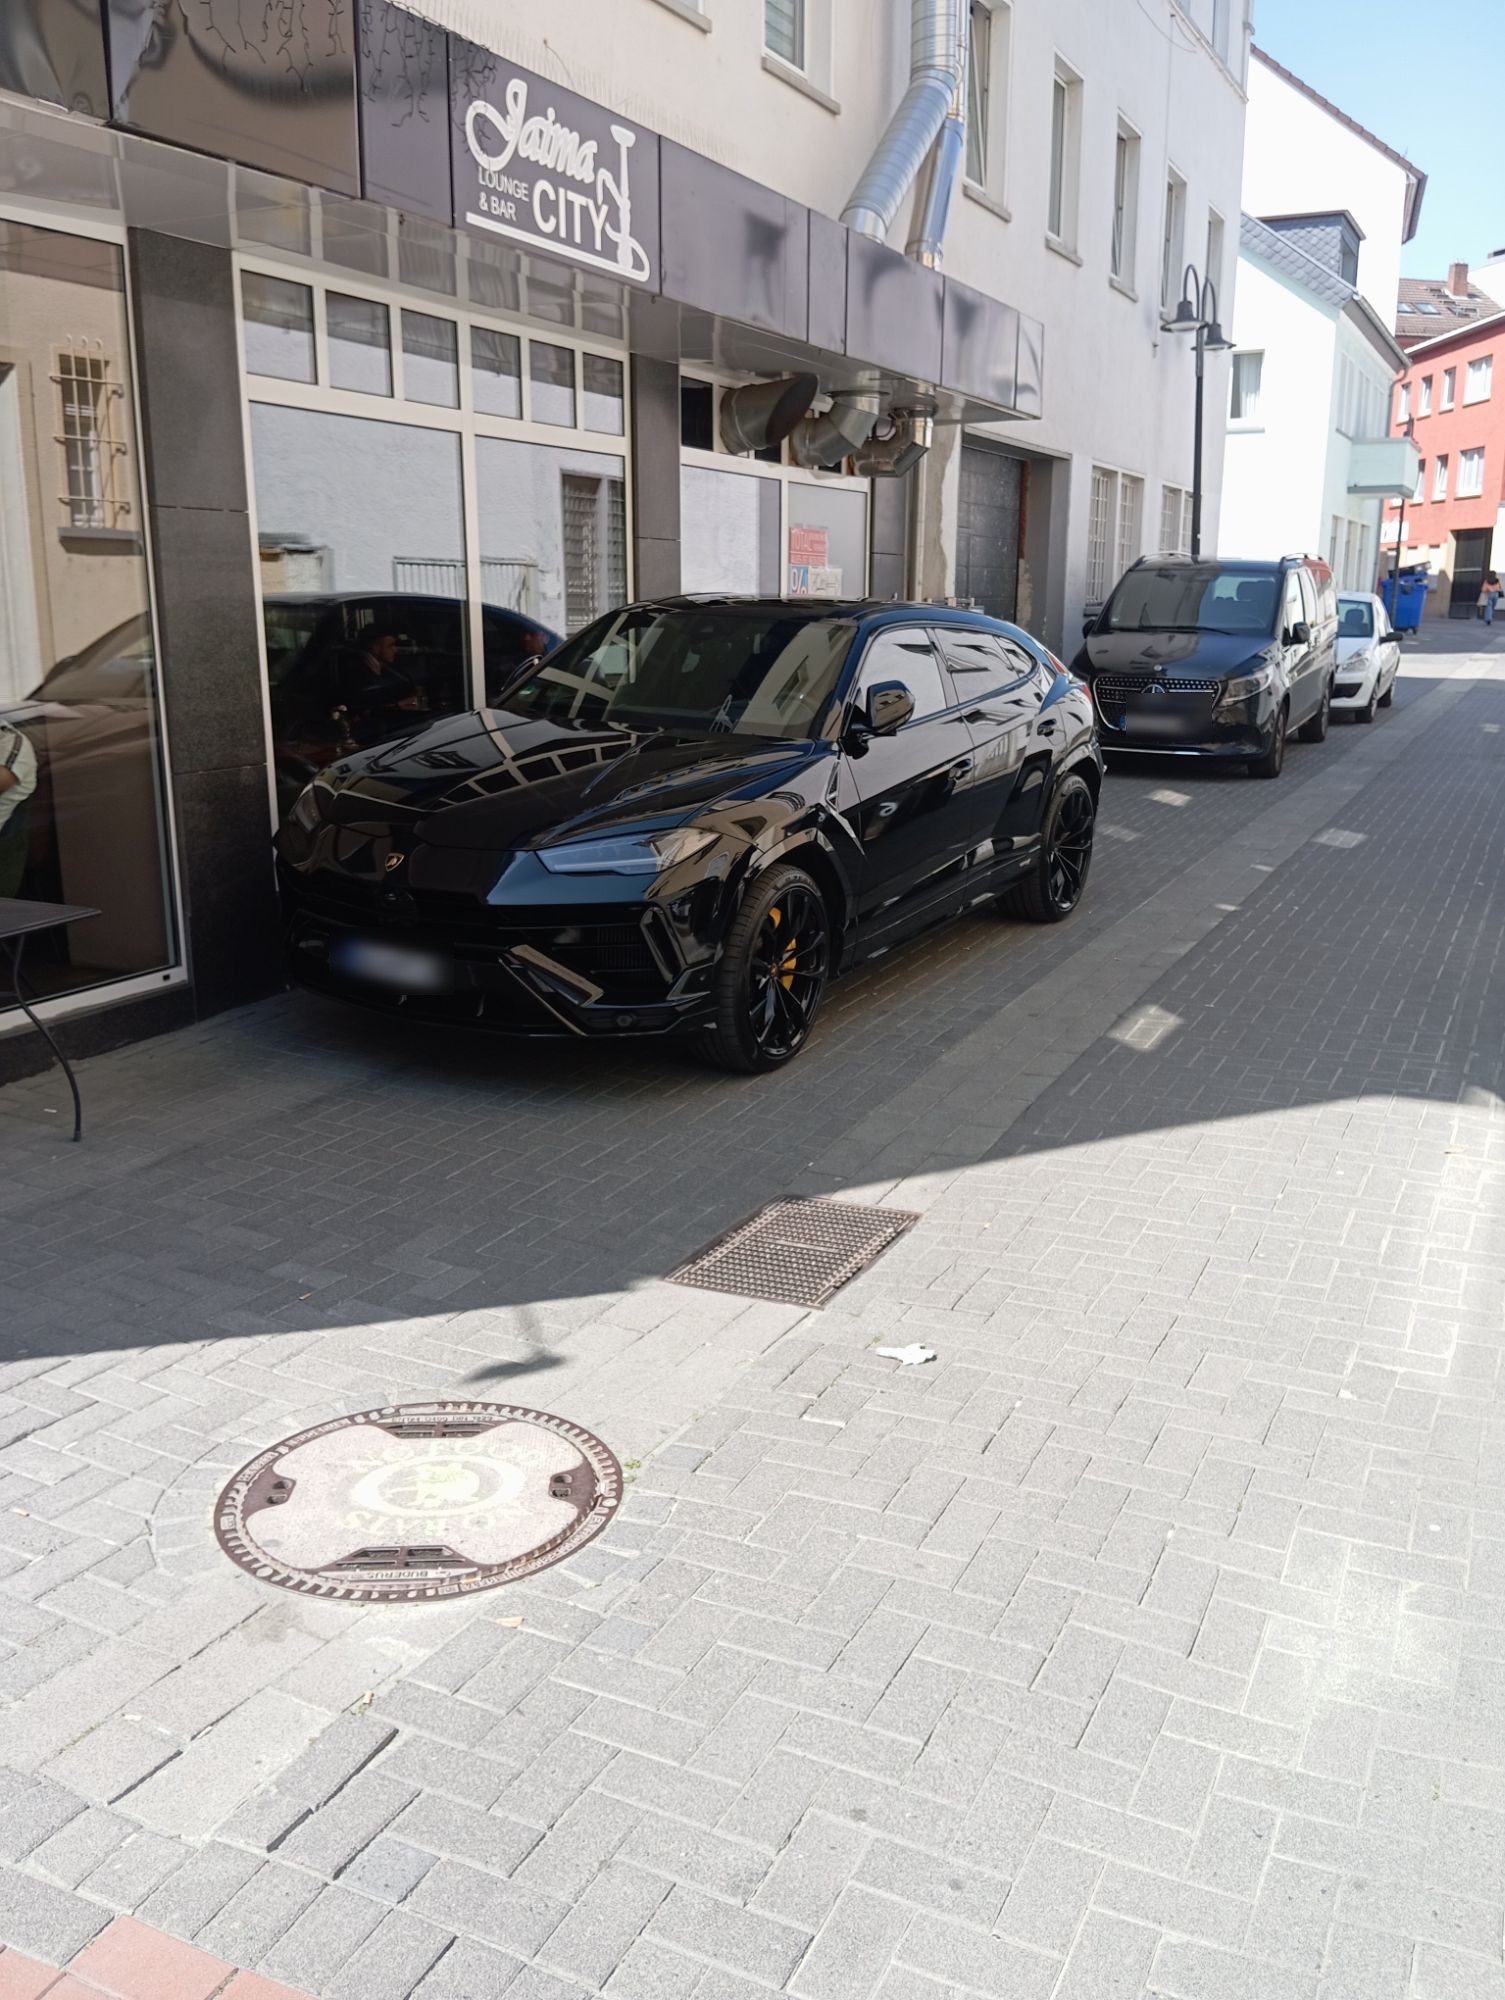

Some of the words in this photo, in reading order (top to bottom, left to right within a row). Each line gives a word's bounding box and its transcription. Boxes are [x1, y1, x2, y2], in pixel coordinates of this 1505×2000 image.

[465, 78, 597, 183] Jaima
[478, 167, 529, 202] LOUNGE
[479, 192, 489, 211] &
[490, 196, 517, 221] BAR
[533, 180, 608, 251] CITY
